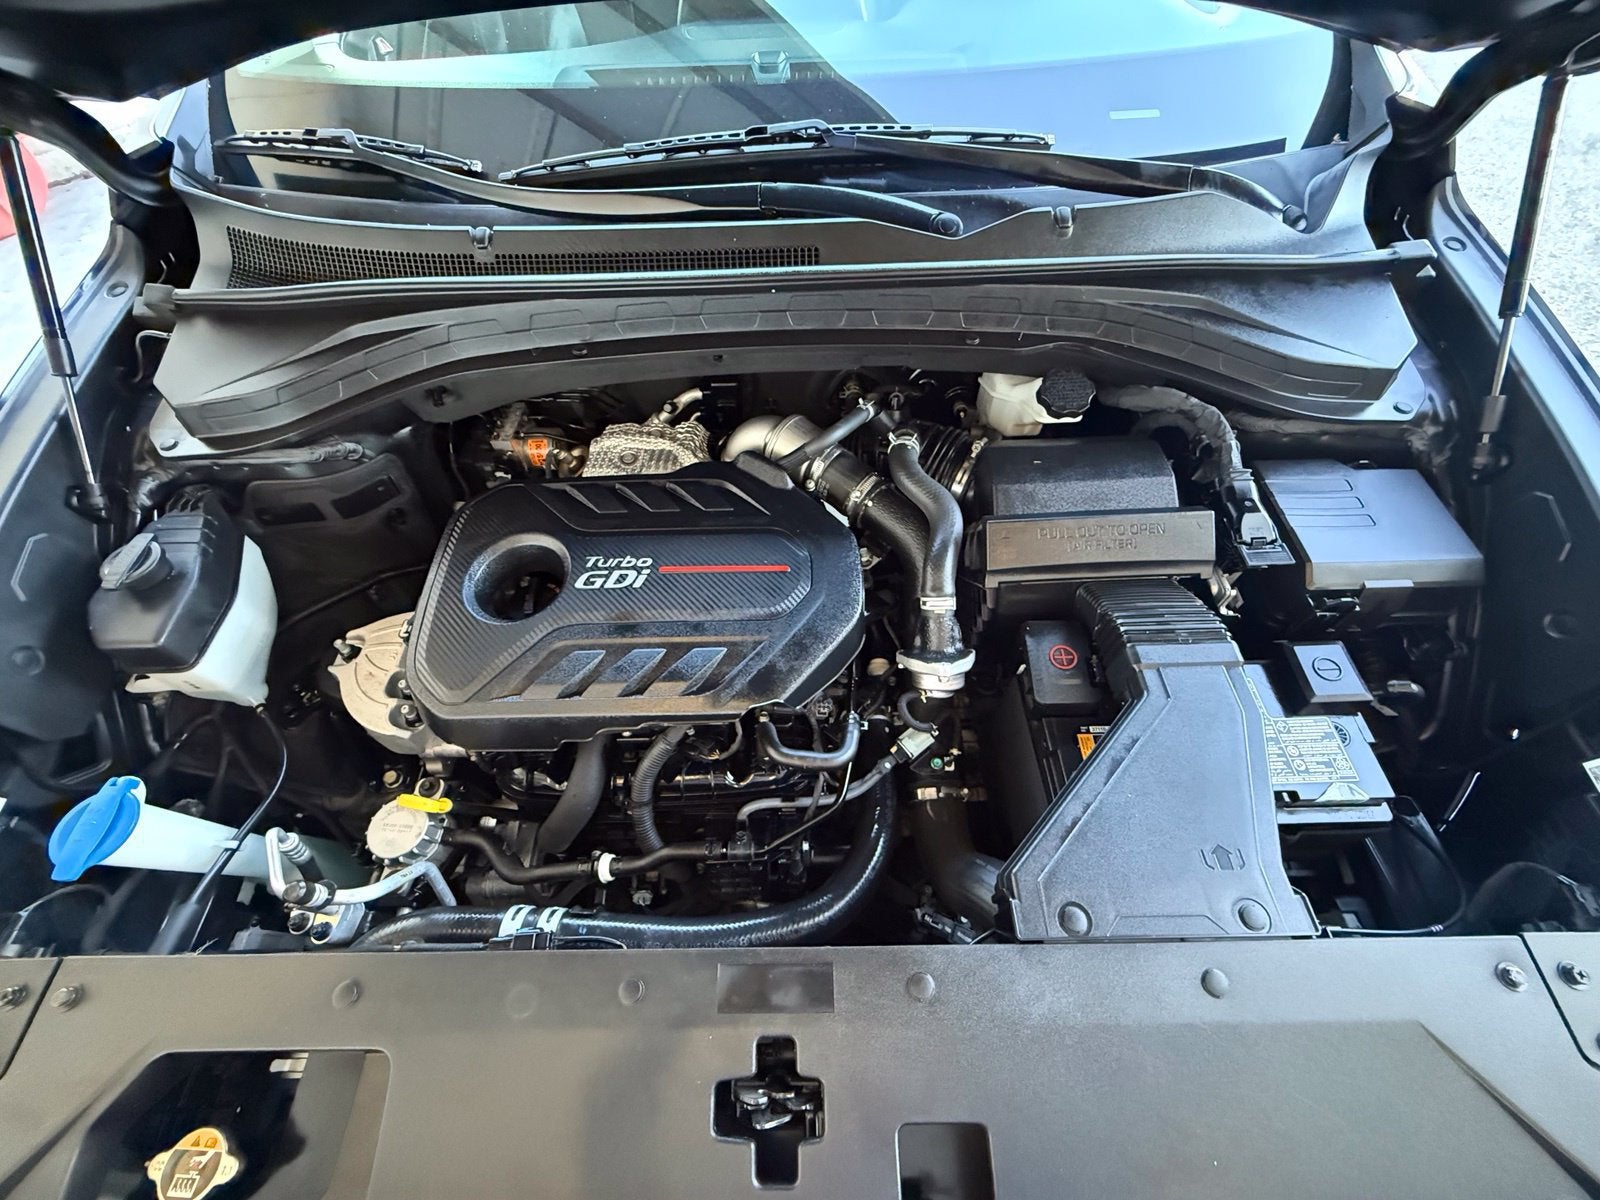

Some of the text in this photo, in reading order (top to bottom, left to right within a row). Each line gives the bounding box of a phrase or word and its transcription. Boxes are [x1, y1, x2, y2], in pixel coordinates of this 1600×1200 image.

[1038, 522, 1166, 540] PULL OUT TO OPEN
[585, 555, 653, 567] Turbo
[574, 568, 651, 589] GDi
